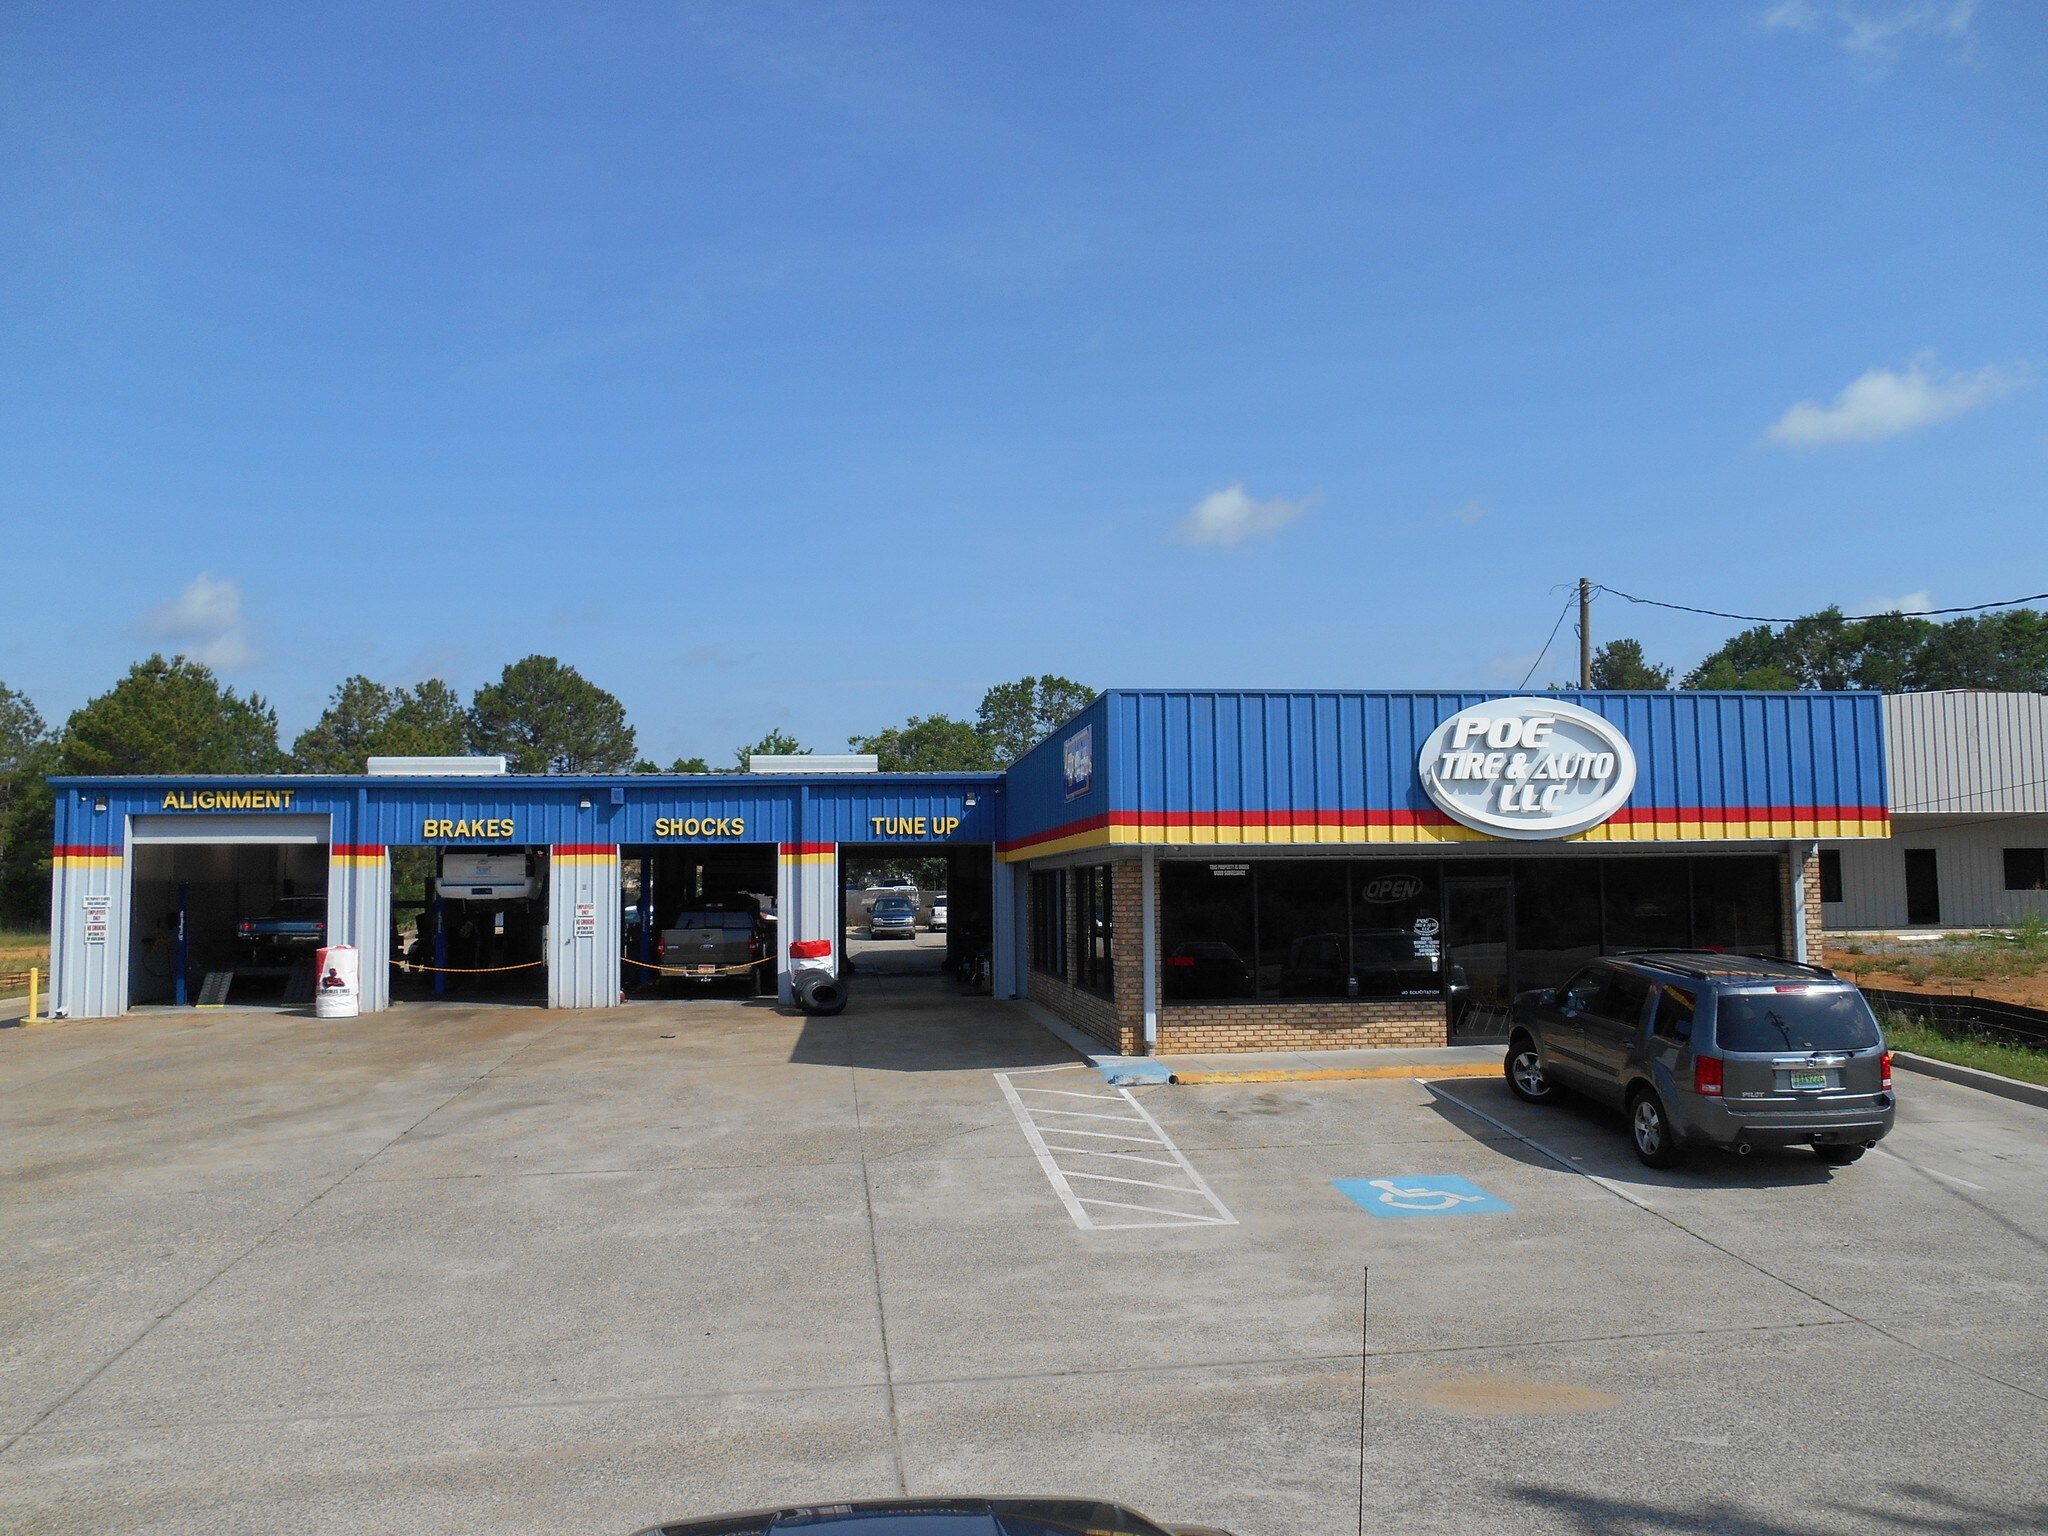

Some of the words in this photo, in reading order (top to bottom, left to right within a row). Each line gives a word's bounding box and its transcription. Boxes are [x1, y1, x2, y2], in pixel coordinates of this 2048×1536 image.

[1451, 716, 1557, 749] POE
[1439, 752, 1506, 780] TIRE
[1504, 752, 1528, 780] &
[1532, 752, 1616, 780] AUTO
[162, 790, 294, 809] ALIGNMENT
[1498, 784, 1568, 813] LLC
[423, 818, 514, 838] BRAKES
[655, 817, 745, 837] SHOCKS
[872, 816, 927, 836] TUNE
[932, 816, 960, 836] UP
[1366, 880, 1417, 898] OPEN
